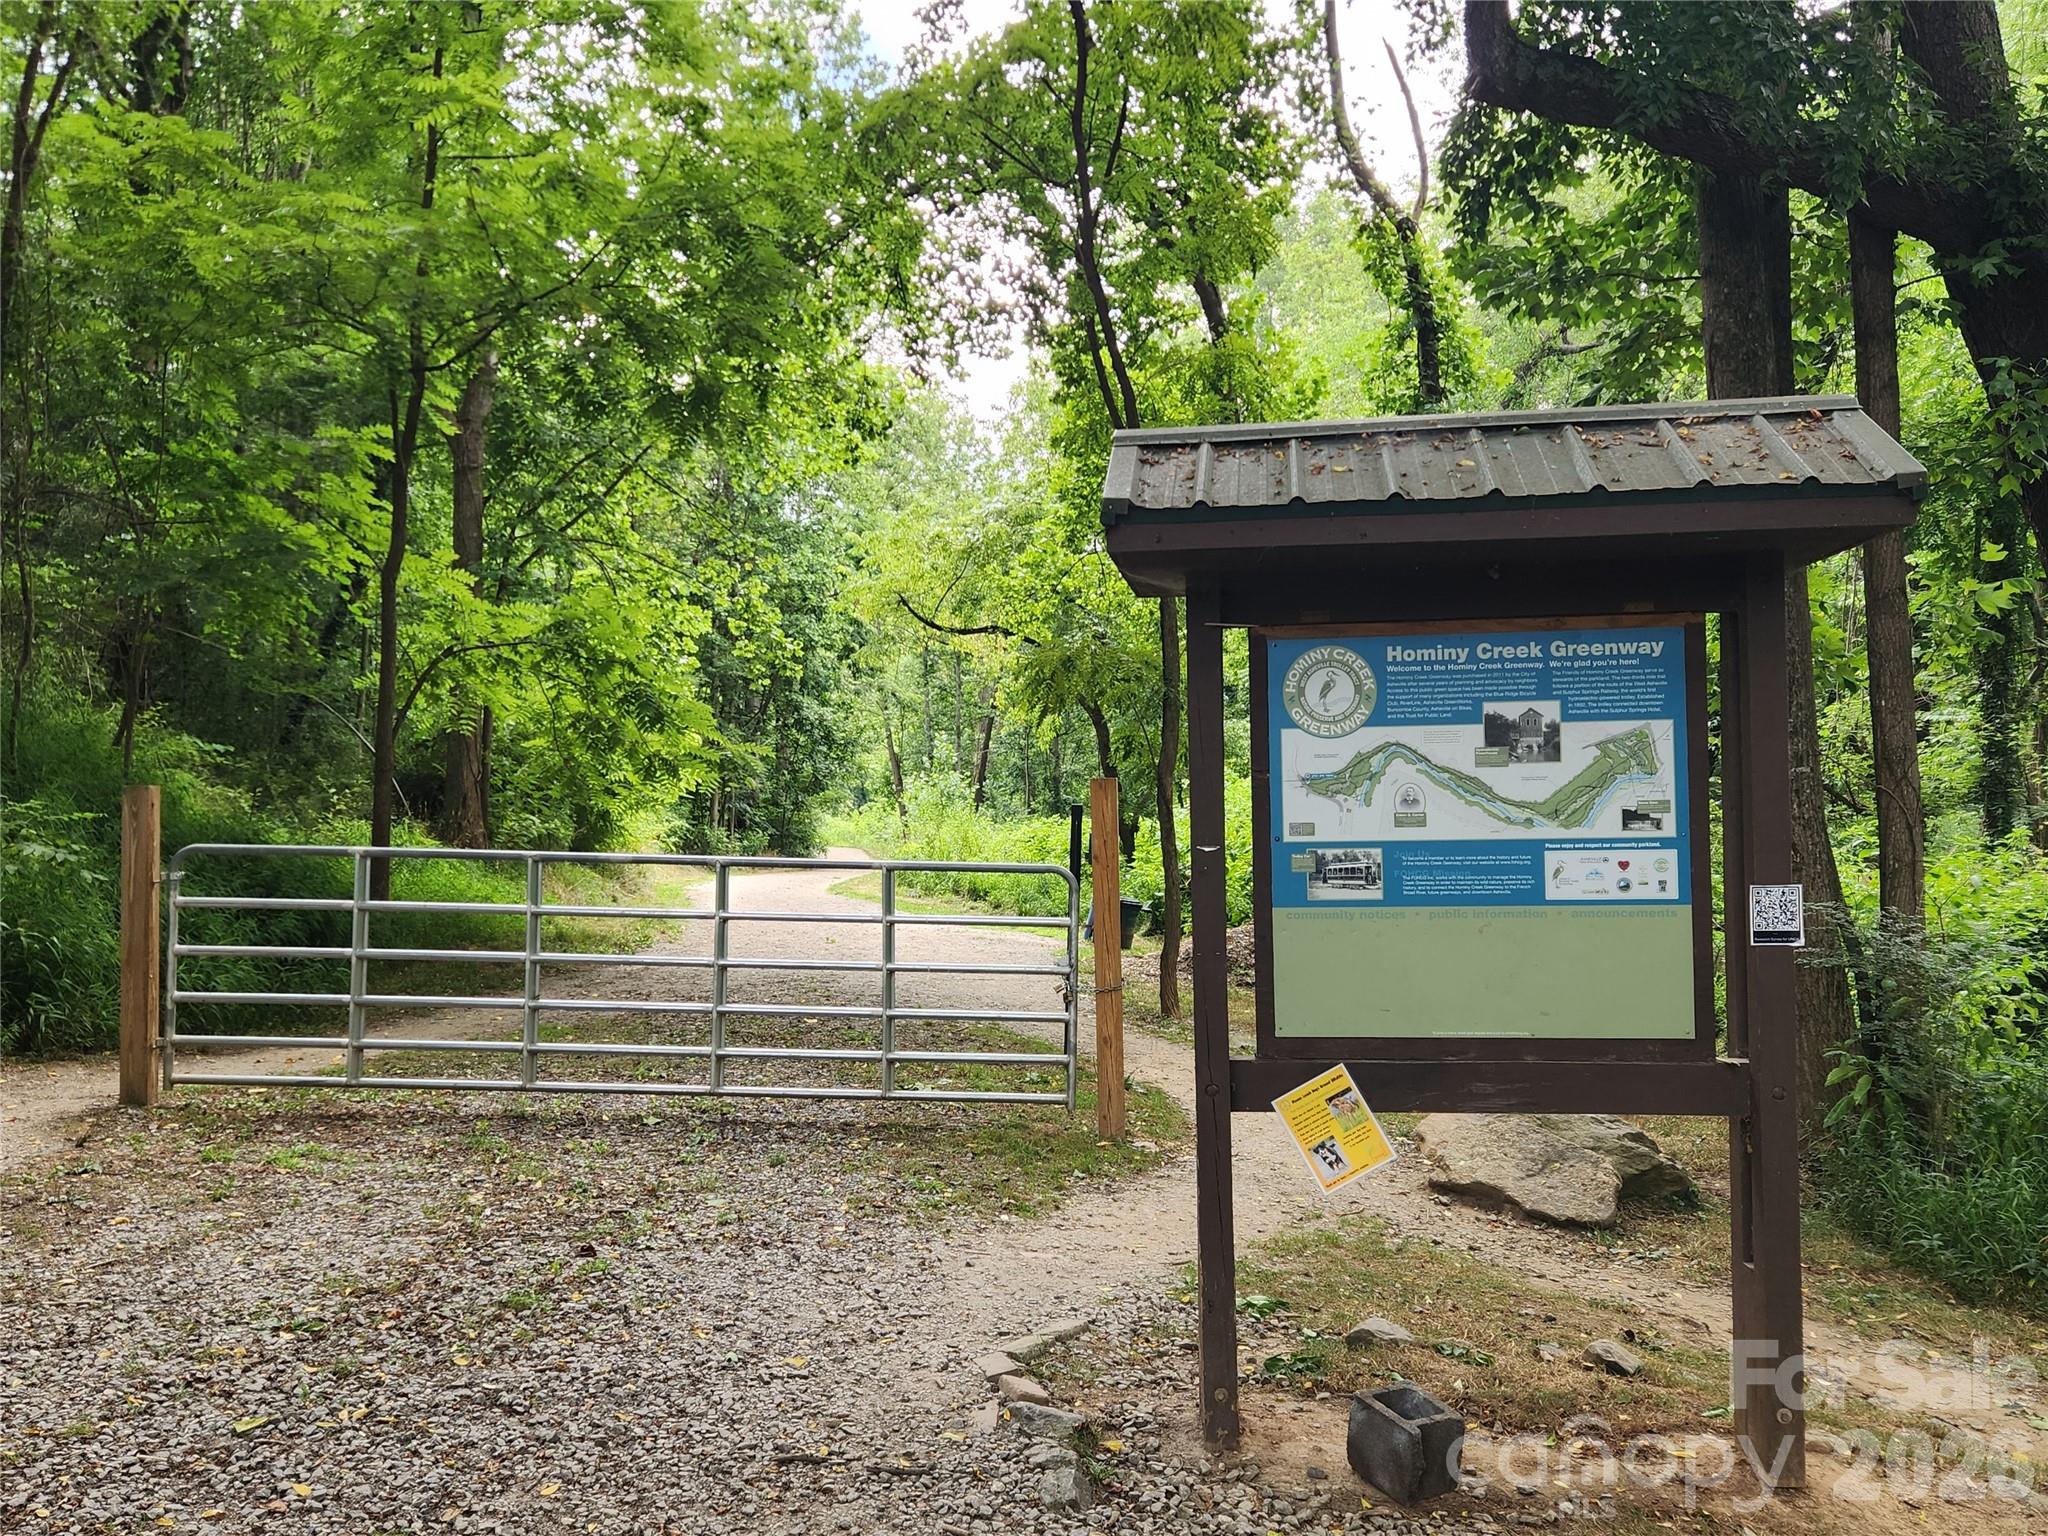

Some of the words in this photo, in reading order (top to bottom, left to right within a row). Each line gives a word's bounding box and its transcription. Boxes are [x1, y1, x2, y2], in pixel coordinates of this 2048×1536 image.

[1386, 645, 1469, 662] Hominy
[1476, 642, 1543, 660] Creek
[1550, 640, 1664, 658] Greenway
[1286, 648, 1330, 692] HOMINY
[1332, 649, 1375, 690] CREEK
[1386, 664, 1422, 672] Welcome
[1448, 663, 1478, 672] Hominy
[1479, 662, 1502, 670] Creek
[1504, 662, 1545, 670] Greenway.
[1550, 660, 1572, 668] We're
[1574, 660, 1590, 668] glad
[1592, 659, 1618, 668] you're
[1292, 704, 1369, 736] GREENWAY
[1286, 910, 1356, 922] community
[1360, 910, 1406, 920] notices
[1429, 909, 1468, 920] public
[1472, 908, 1548, 918] information
[1571, 908, 1678, 919] announcements
